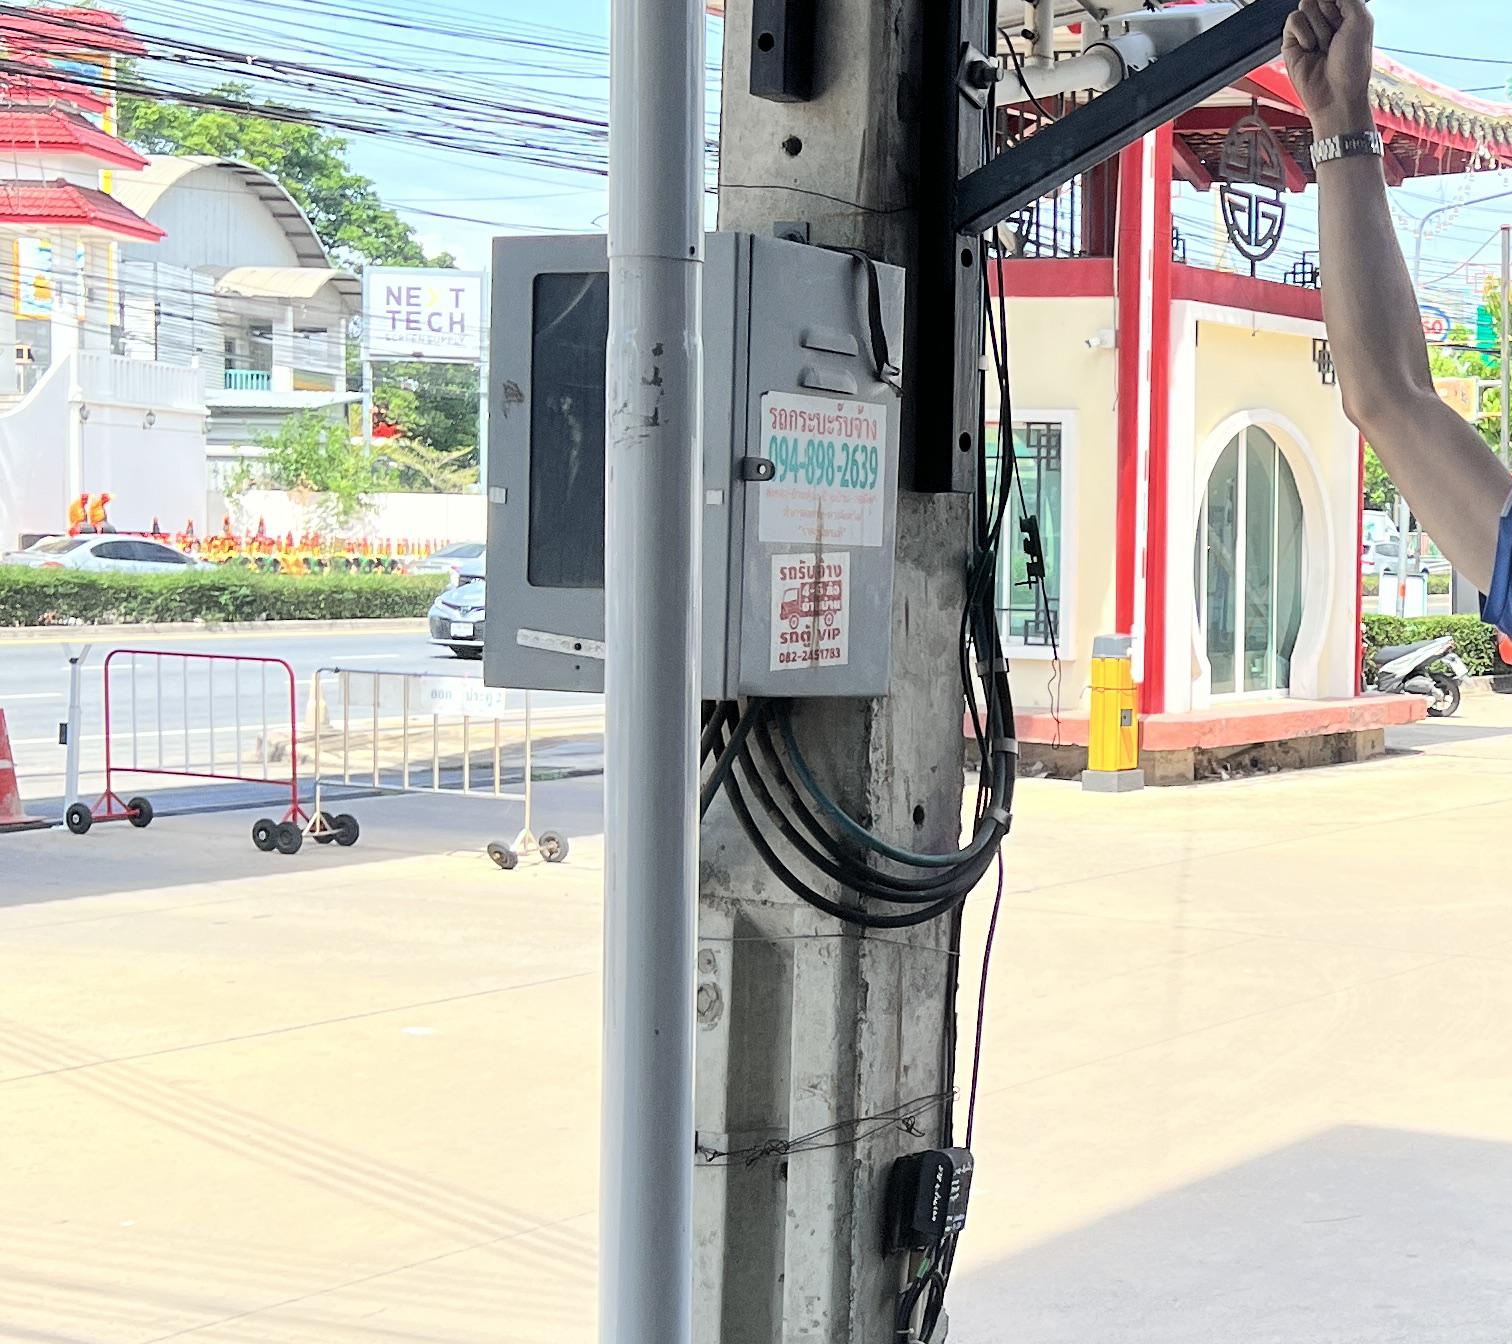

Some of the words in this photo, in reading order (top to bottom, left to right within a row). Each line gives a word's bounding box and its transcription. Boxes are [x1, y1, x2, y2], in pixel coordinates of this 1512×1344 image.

[386, 310, 465, 333] TECH
[769, 402, 878, 441] รถกระบะรับจ้าง
[768, 435, 878, 490] 094-898-2639
[817, 628, 841, 641] VIP
